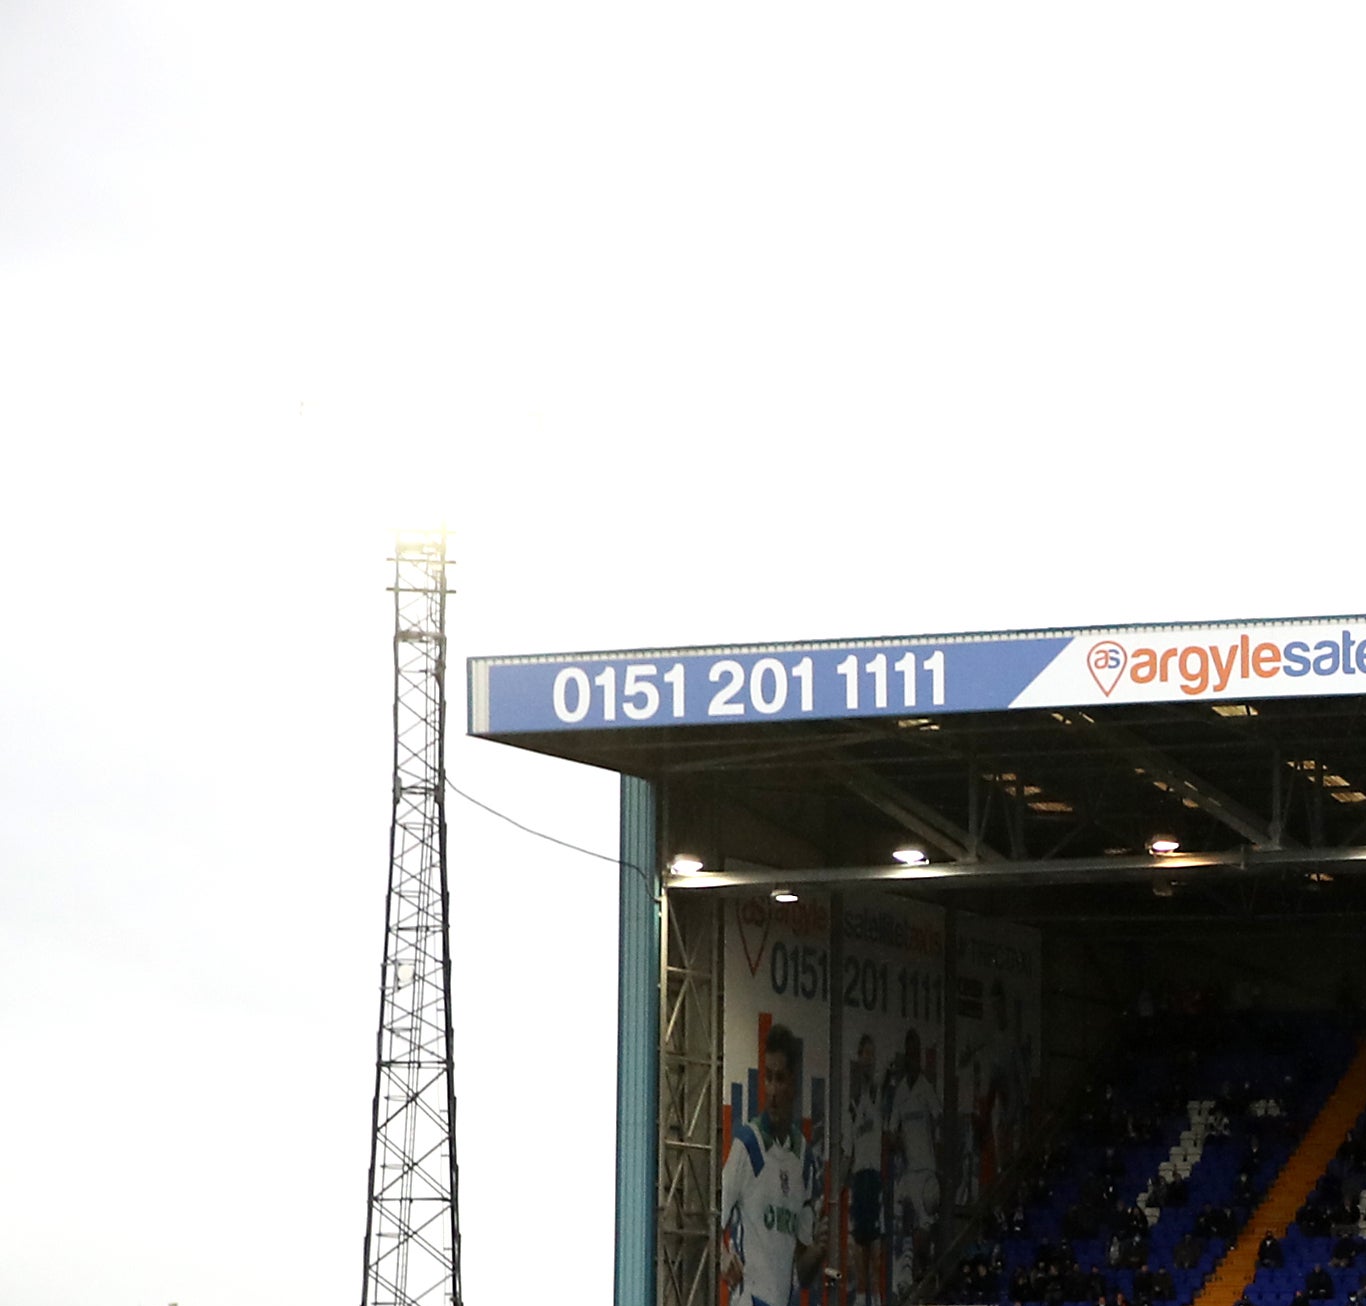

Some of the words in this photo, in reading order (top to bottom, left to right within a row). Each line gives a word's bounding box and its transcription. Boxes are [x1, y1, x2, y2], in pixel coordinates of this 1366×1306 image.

[552, 662, 685, 723] 0151
[707, 657, 814, 716] 201
[836, 650, 945, 709] 1111
[771, 941, 828, 1003] 0151
[843, 954, 888, 1014] 201
